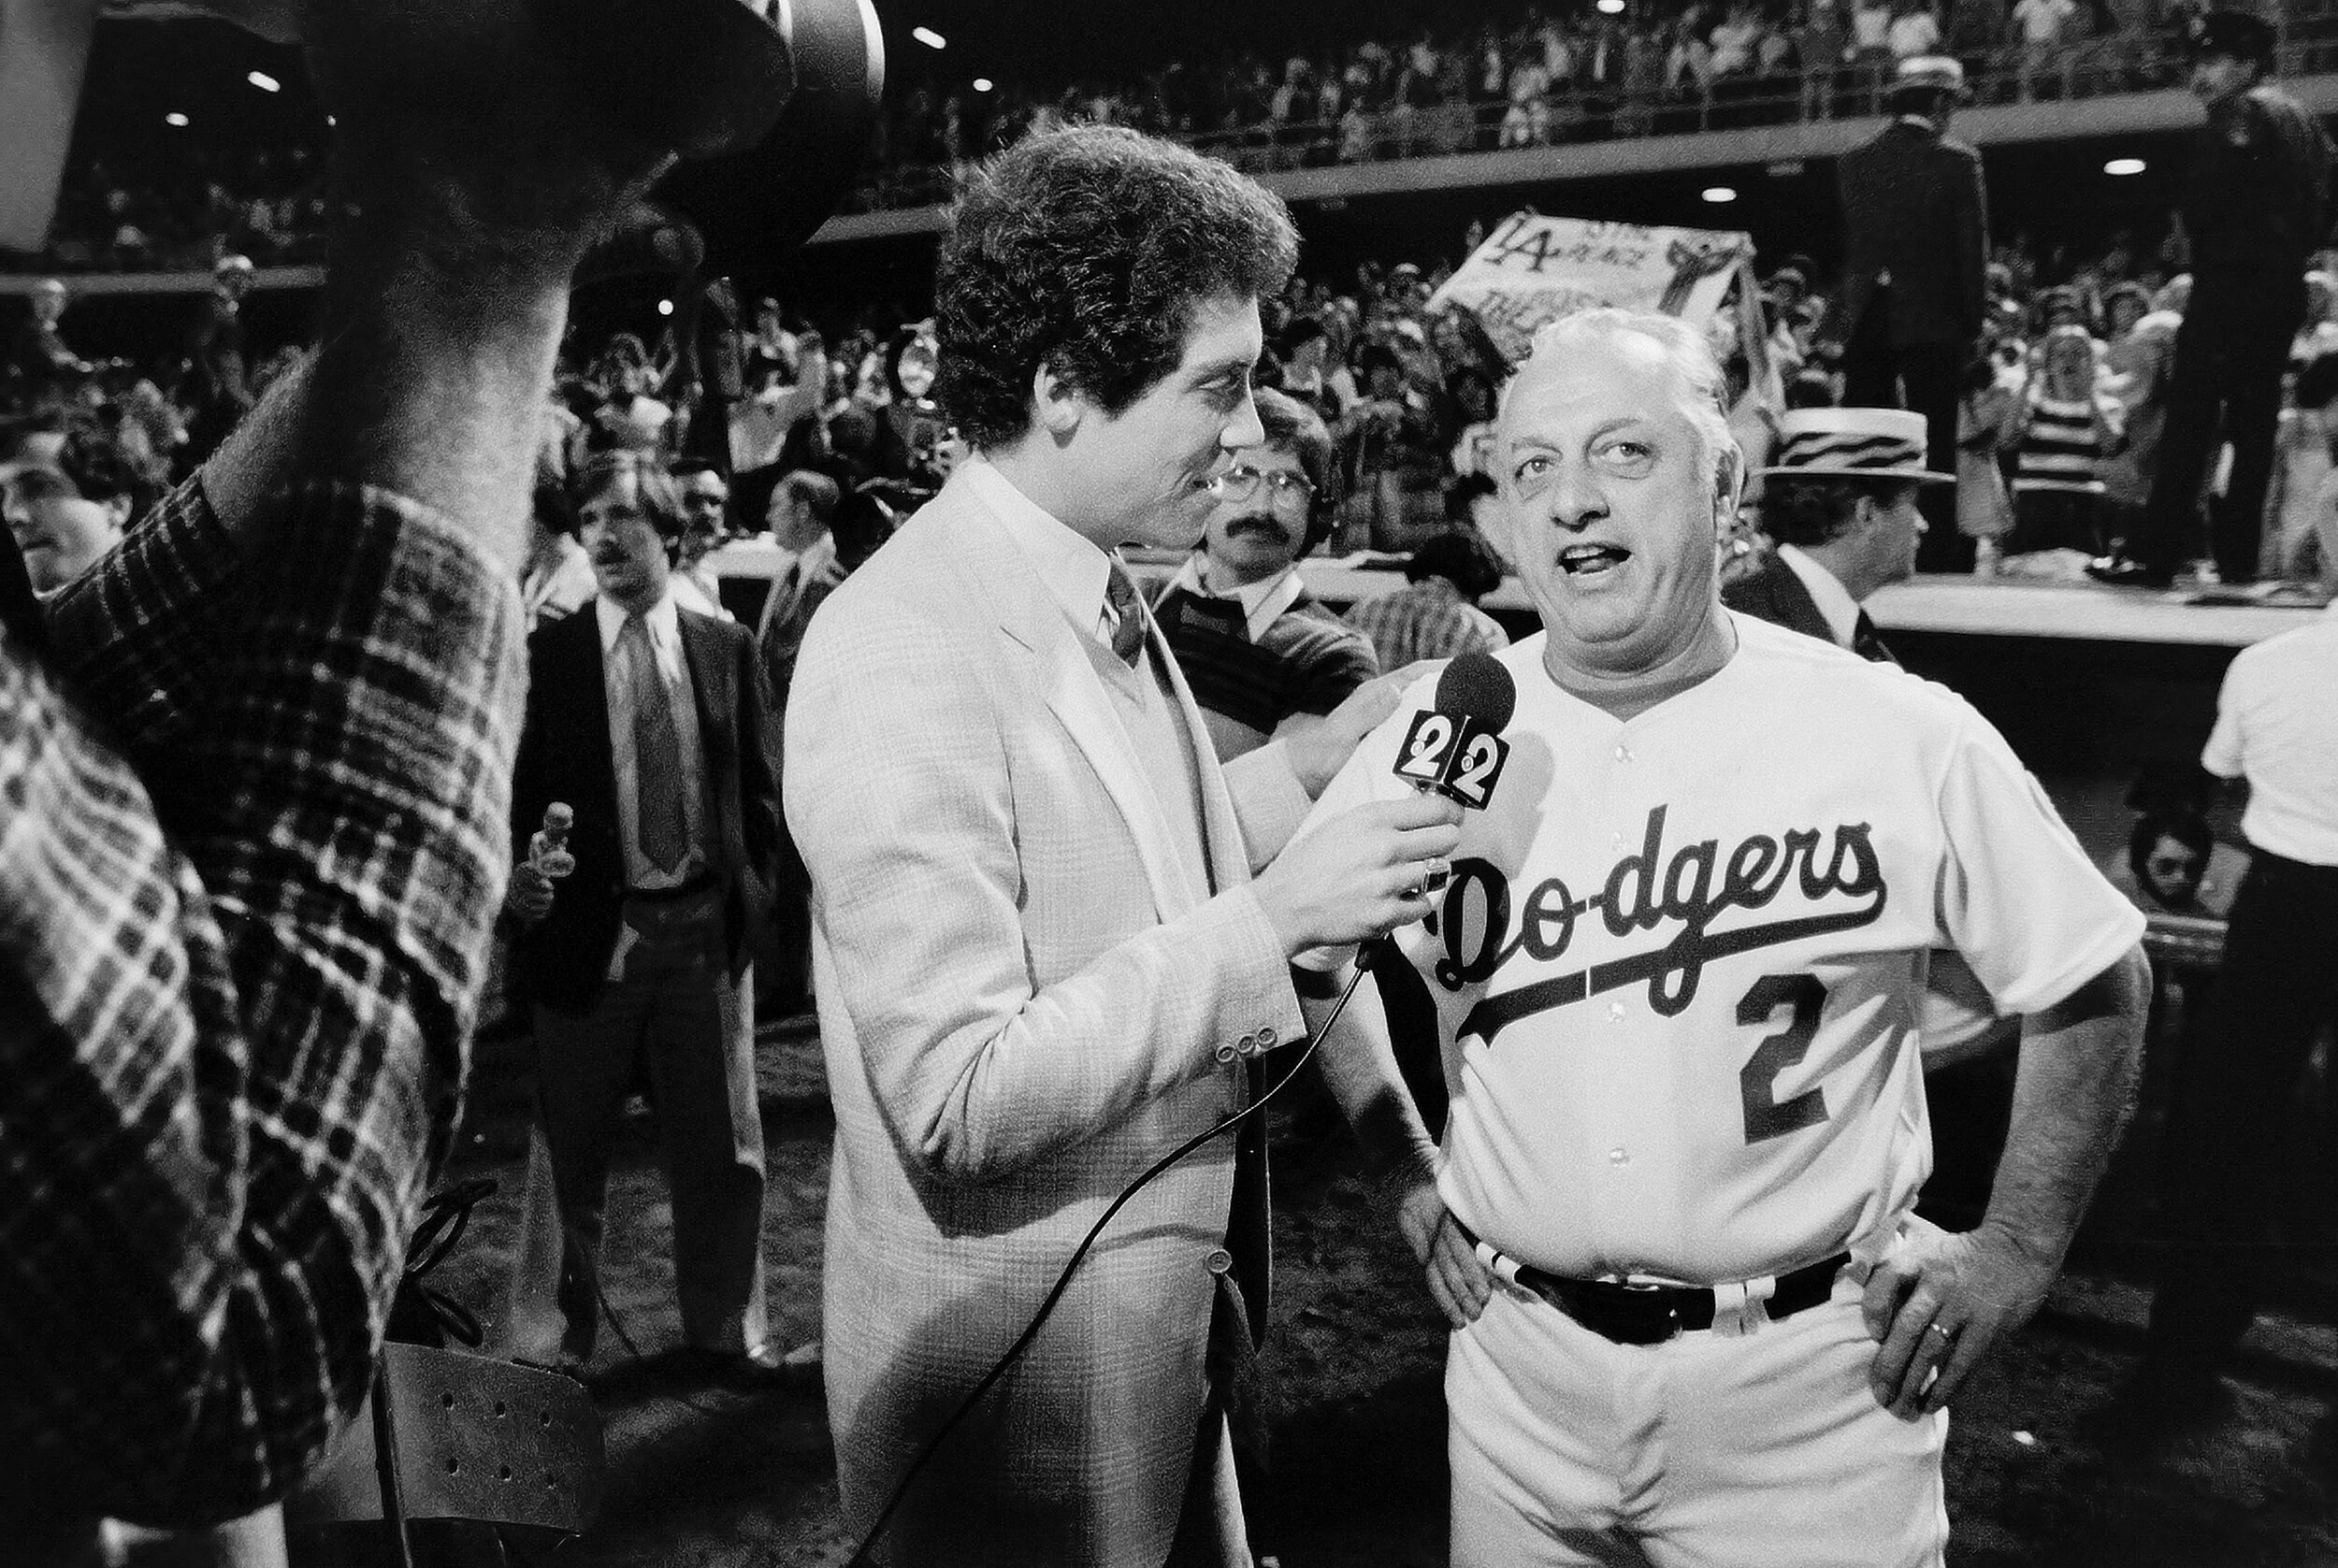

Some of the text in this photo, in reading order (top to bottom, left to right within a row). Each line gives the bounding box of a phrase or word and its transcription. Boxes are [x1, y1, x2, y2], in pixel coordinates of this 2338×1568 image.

[1401, 714, 1451, 777] 2
[1452, 732, 1498, 803] 2
[1422, 803, 1887, 1018] Dodgers
[1736, 973, 1829, 1144] 2
